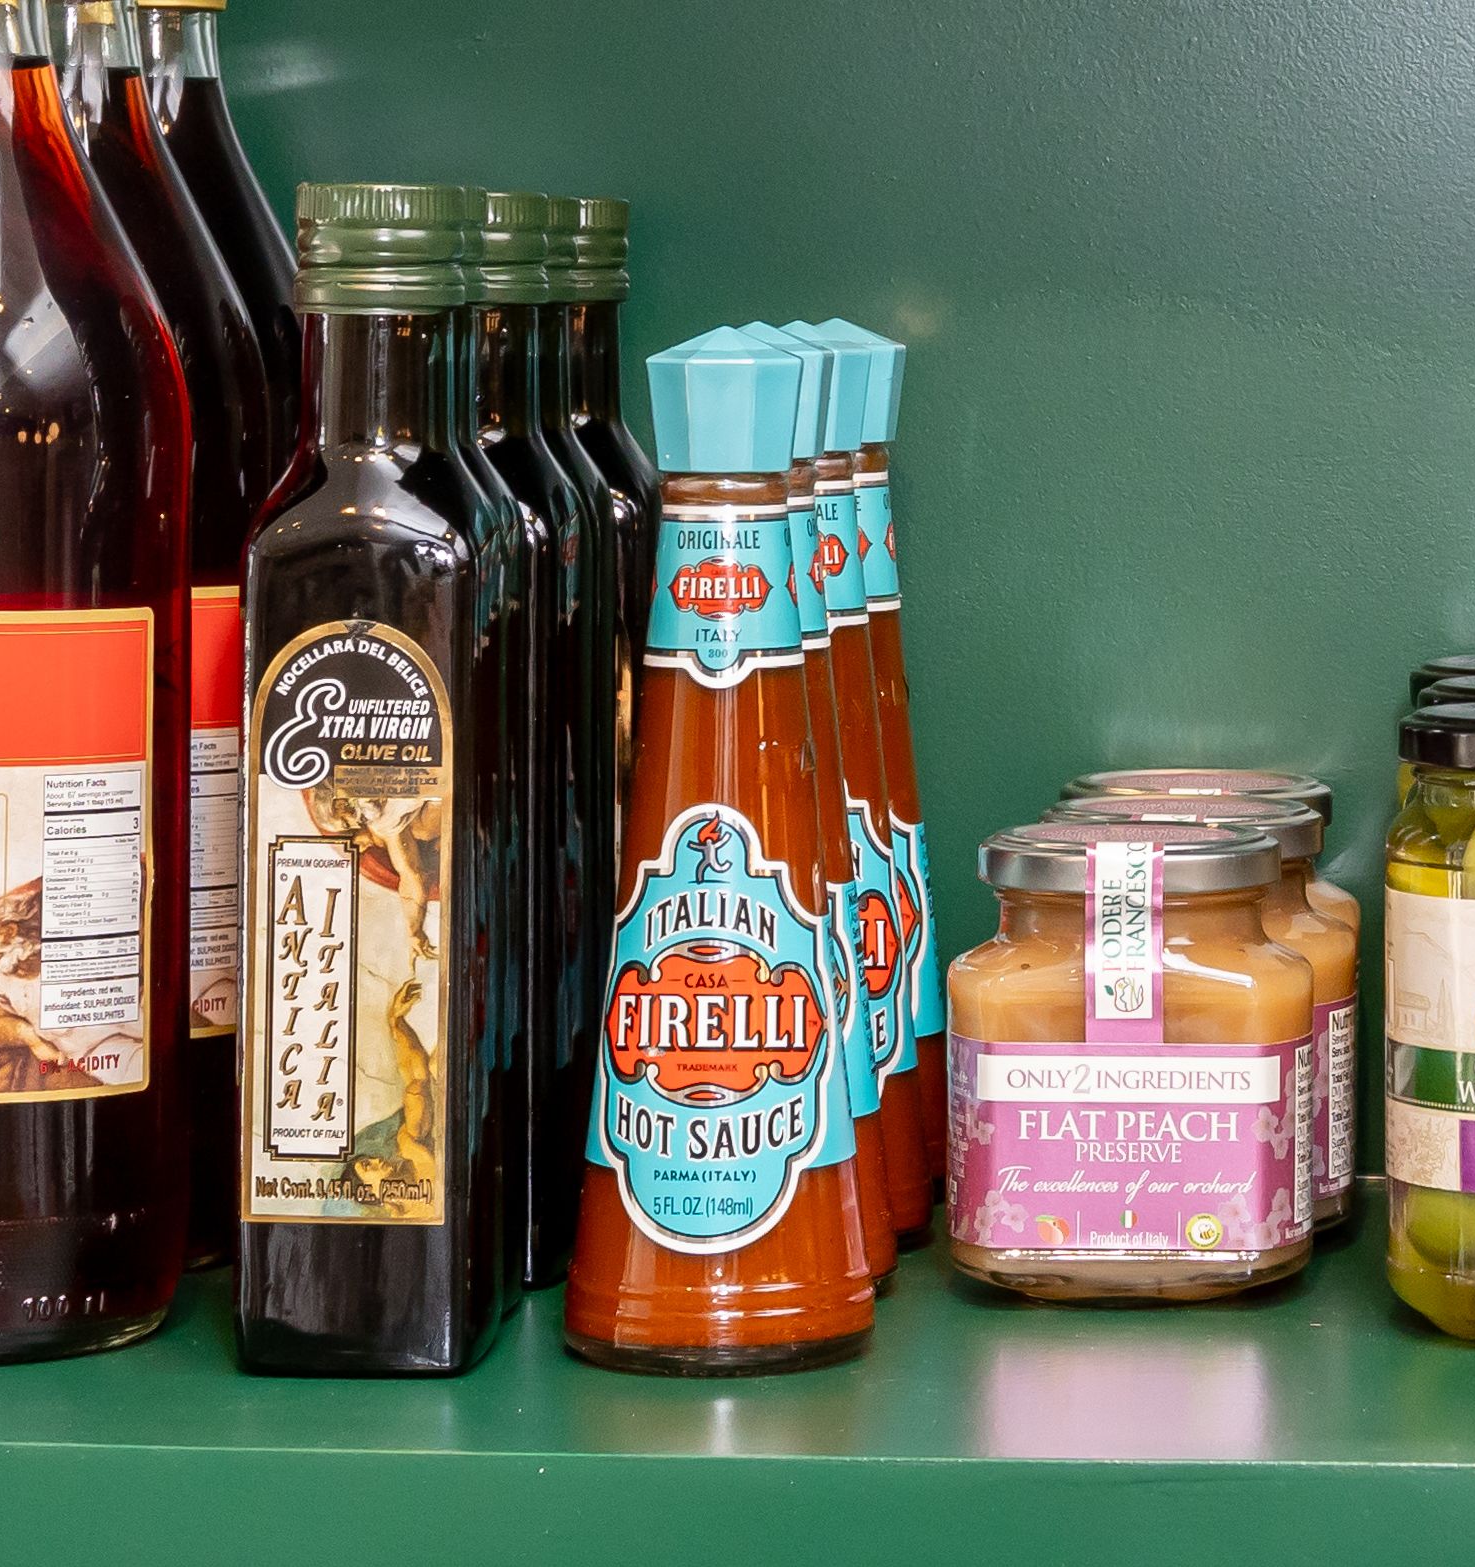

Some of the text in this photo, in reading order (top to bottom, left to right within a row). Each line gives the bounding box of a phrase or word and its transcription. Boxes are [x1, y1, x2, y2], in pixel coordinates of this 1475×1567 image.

[677, 529, 761, 552] ORIGINALE
[677, 574, 761, 600] FIRELLI
[696, 627, 741, 643] ITALY
[275, 639, 428, 698] NOCELLARA DEL BELICE
[349, 699, 430, 715] UNFILTERED
[370, 717, 433, 740] VIRGIN
[340, 744, 432, 762] OLIVE OIL
[47, 780, 84, 788] Nutrition
[47, 818, 138, 835] Calories 3
[277, 858, 351, 868] PREMIUM GOURMET
[645, 889, 777, 951] ITALIAN
[1102, 879, 1123, 973] PODERE
[276, 875, 314, 1109] ANTICA
[684, 973, 730, 989] CASA
[616, 994, 809, 1051] FIRELLI
[68, 1054, 121, 1073] ACIDITY
[1007, 1063, 1252, 1095] ONLY 2 INGREDIENTS
[272, 1128, 345, 1139] PRODUCT OF ITALY
[616, 1095, 804, 1161] HOT SAUCE
[1018, 1109, 1239, 1142] FLAT PEACH
[1075, 1141, 1182, 1164] PRESERVE
[997, 1164, 1256, 1205] The excellences of our orchard
[653, 1197, 661, 1216] 5
[705, 1196, 753, 1218] (148ml)
[1090, 1231, 1169, 1250] Product of Italy
